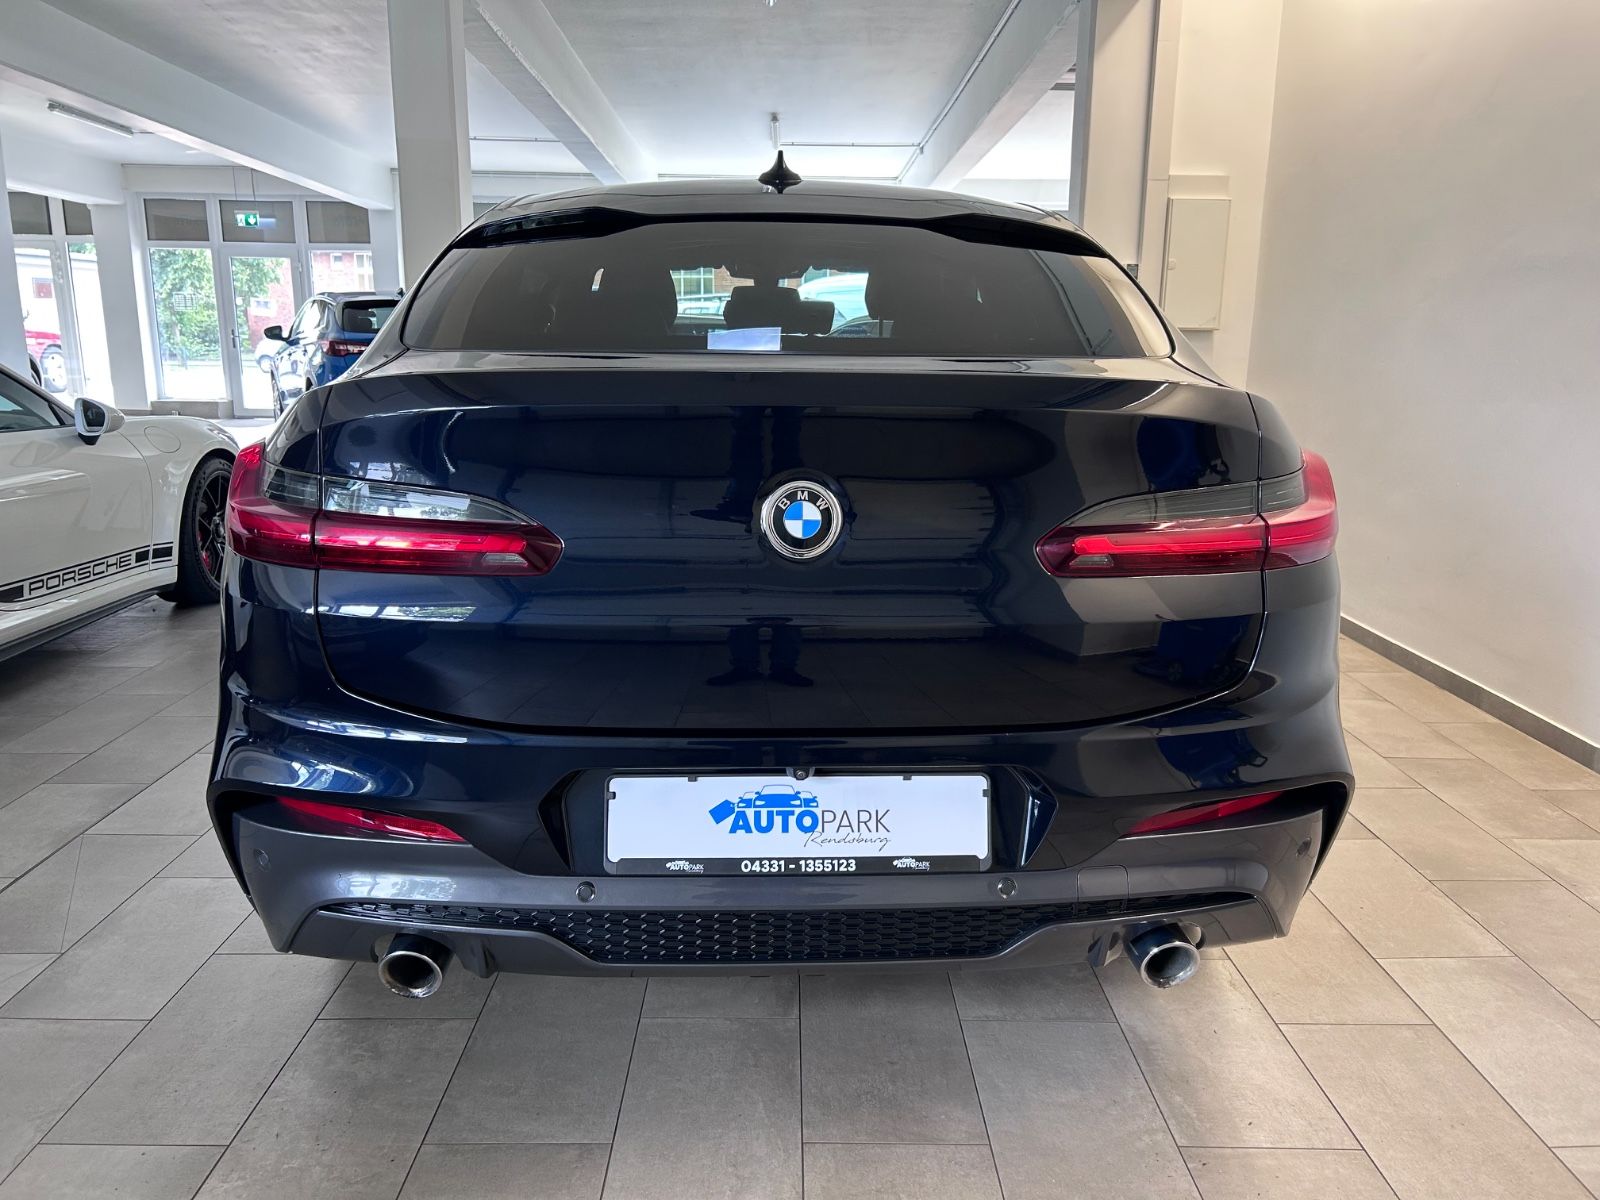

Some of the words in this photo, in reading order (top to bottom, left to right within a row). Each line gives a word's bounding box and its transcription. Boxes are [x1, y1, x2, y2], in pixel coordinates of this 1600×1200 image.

[778, 490, 829, 510] BMW
[29, 554, 132, 595] PORSCHE
[803, 830, 892, 852] Rendsburg
[741, 860, 785, 872] 04331
[800, 859, 856, 872] 1355123
